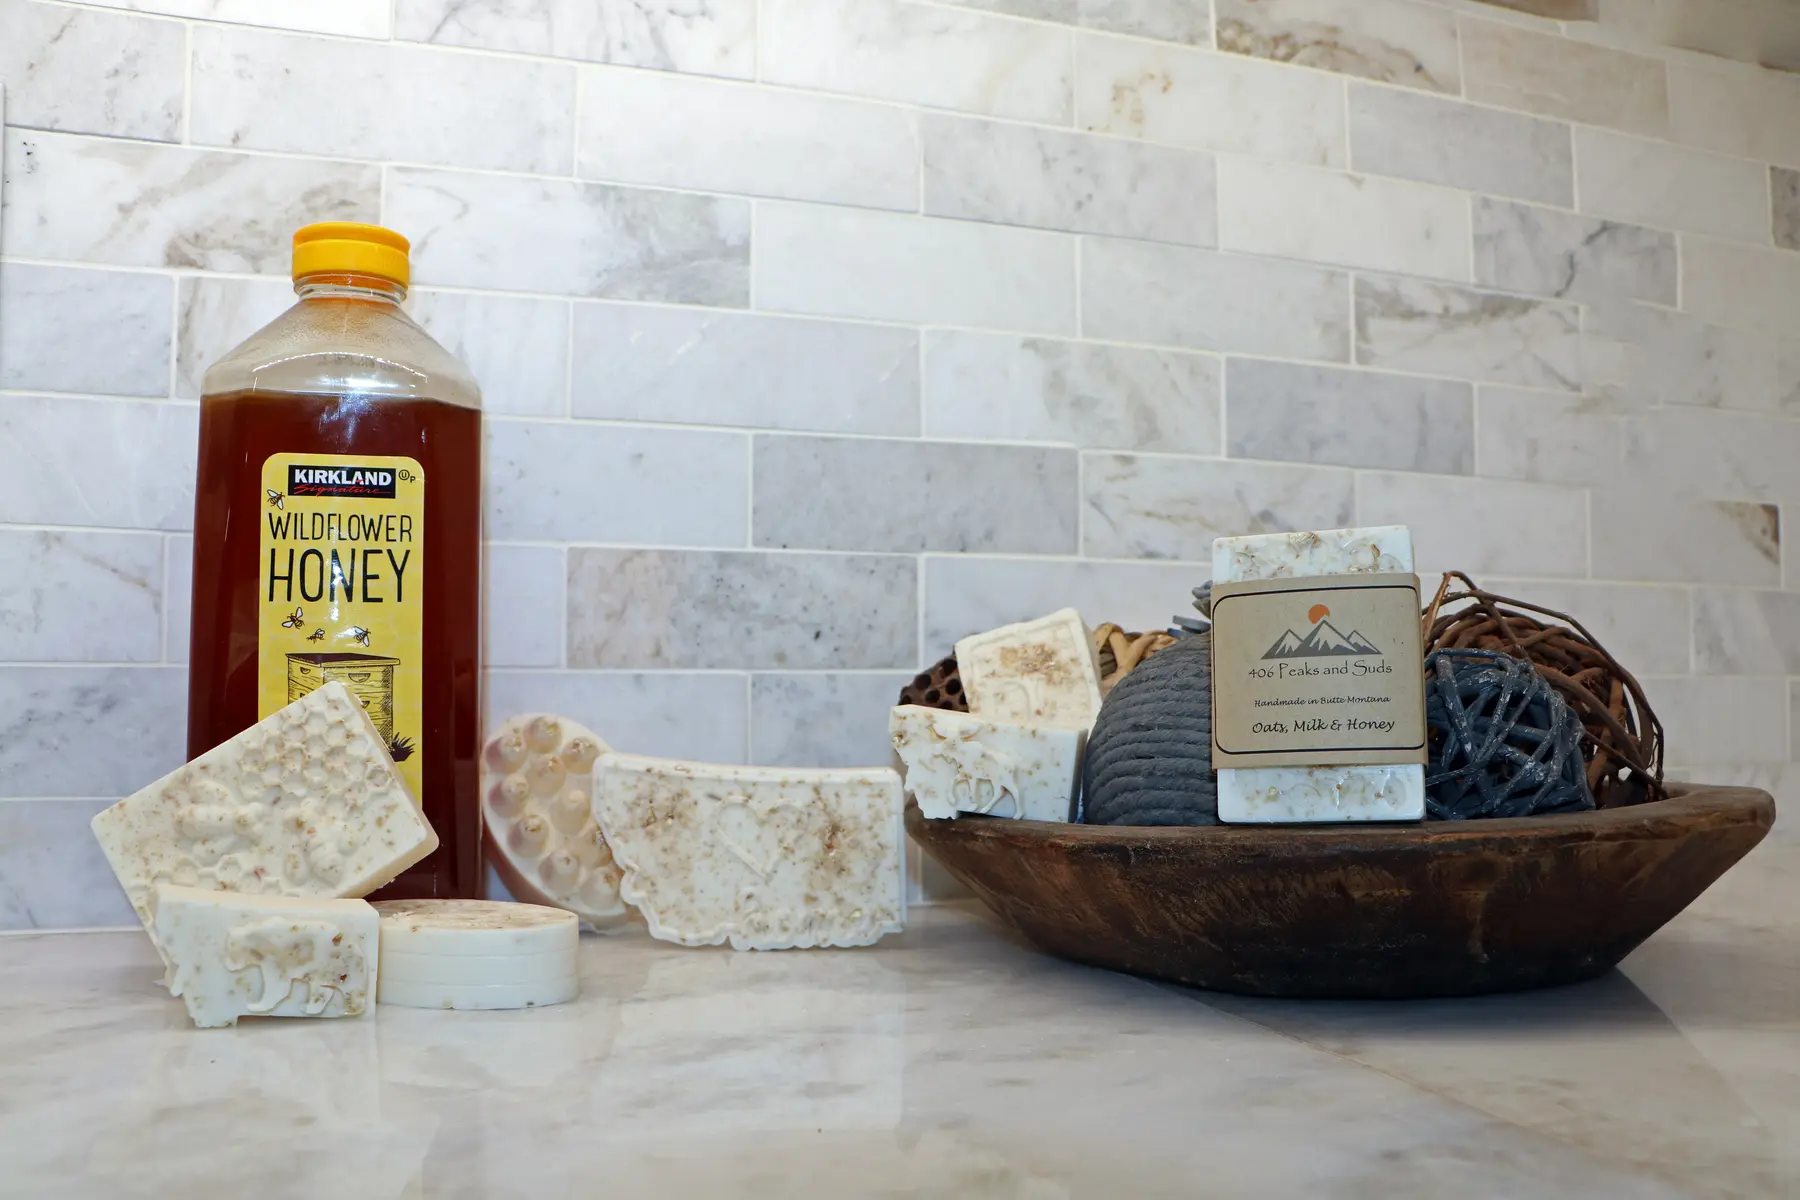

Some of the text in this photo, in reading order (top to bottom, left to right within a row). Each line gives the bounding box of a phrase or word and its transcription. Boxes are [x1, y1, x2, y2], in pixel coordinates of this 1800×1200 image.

[294, 469, 392, 486] KIRKLAND
[294, 483, 392, 497] Signature
[268, 512, 412, 542] WILDFLOWER
[268, 548, 411, 603] HONEY
[1248, 659, 1393, 679] 406 Peaks and Suds
[1254, 697, 1307, 708] Handmade
[1320, 696, 1346, 705] Butte
[1347, 695, 1392, 704] Montana
[1252, 718, 1396, 734] Oats, Milk & Honey
